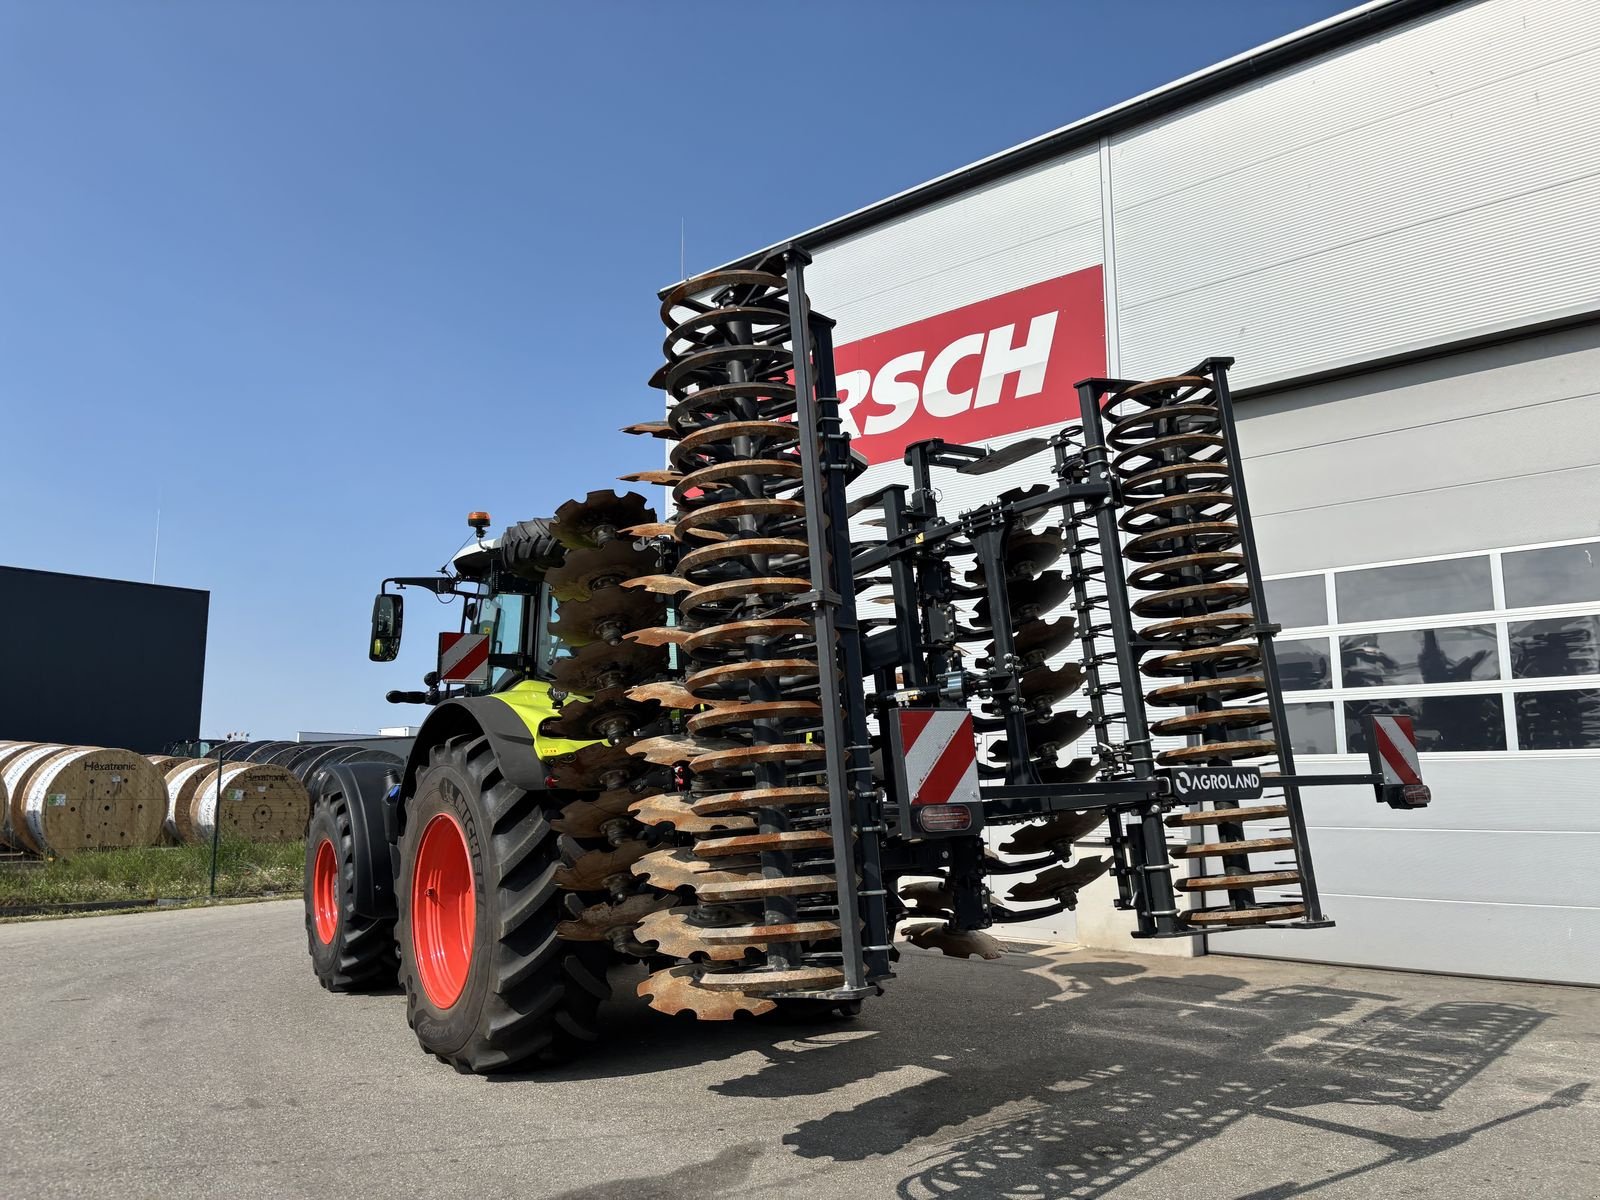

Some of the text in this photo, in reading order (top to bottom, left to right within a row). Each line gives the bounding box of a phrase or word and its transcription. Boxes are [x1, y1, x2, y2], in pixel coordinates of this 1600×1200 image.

[785, 310, 1059, 452] RSCH
[84, 761, 136, 771] Hexatronic
[1192, 773, 1259, 790] AGROLAND
